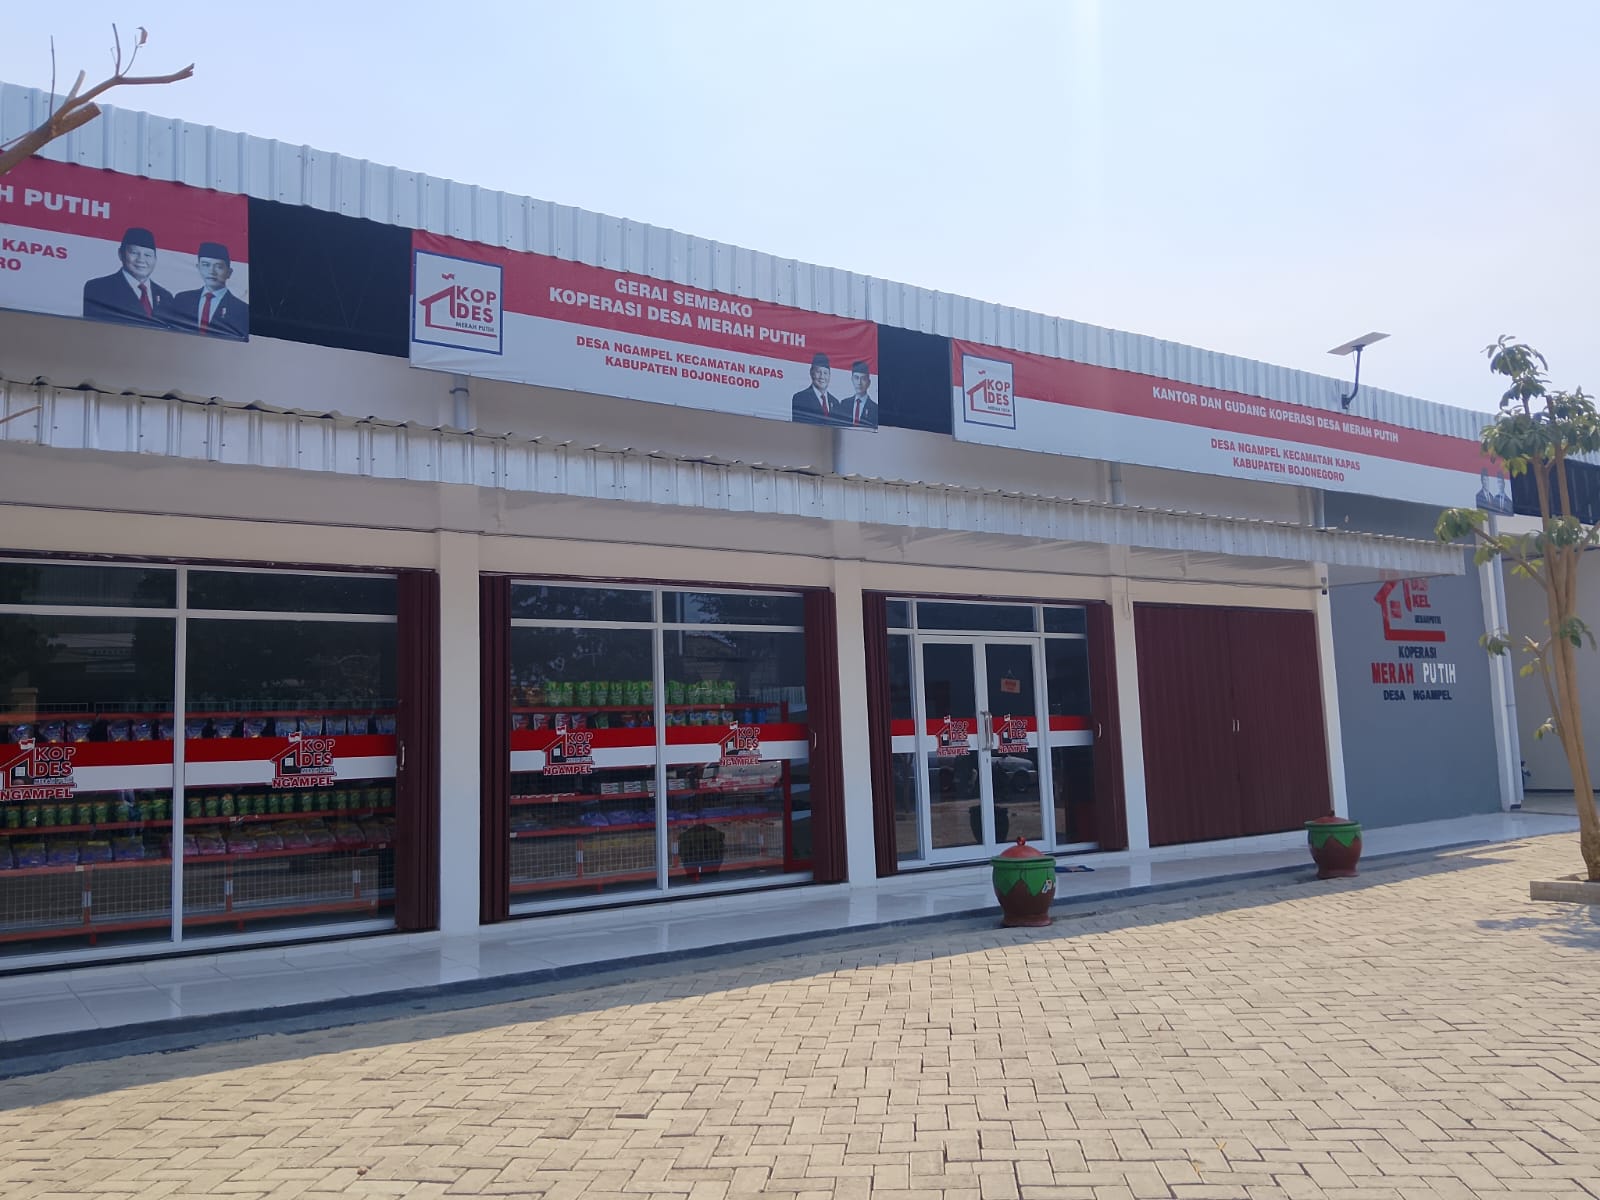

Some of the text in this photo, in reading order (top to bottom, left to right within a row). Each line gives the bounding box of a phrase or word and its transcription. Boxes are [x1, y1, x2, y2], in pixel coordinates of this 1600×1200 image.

[24, 188, 110, 219] PUTIH
[2, 238, 68, 260] KAPAS
[456, 285, 497, 306] KOP
[614, 278, 753, 318] GERAI SEMBAKO
[456, 302, 494, 324] DES
[550, 287, 806, 348] KOPERASI DESA MERAH PUTIH
[576, 335, 784, 379] DESA NGAMPEL KECAMATAN KAPAS
[606, 355, 760, 389] KABUPATEN BOJONEGORO
[988, 379, 1010, 392] KOP
[988, 392, 1010, 406] DES
[1152, 386, 1399, 443] KANTOR DAN GUDANG KOPERASI DESA MERAH PUTIH
[1210, 438, 1361, 471] DESA NGAMPEL KECAMATAN KAPAS
[1233, 456, 1345, 482] KABUPATEN BOJONEGORO
[1398, 646, 1437, 658] KOPERASI
[1371, 662, 1456, 684] MERAH PUTIH
[1383, 690, 1453, 700] DESA NGAMPEL
[566, 732, 594, 744] KOP
[738, 727, 760, 738] KOP
[300, 738, 336, 752] KOP
[566, 744, 592, 756] DES
[738, 737, 759, 749] DES
[34, 746, 77, 761] KOP
[300, 752, 334, 766] DES
[34, 760, 73, 777] DES
[543, 764, 592, 776] NGAMPEL
[272, 775, 334, 788] NGAMPEL
[0, 787, 74, 800] NGAMPEL
